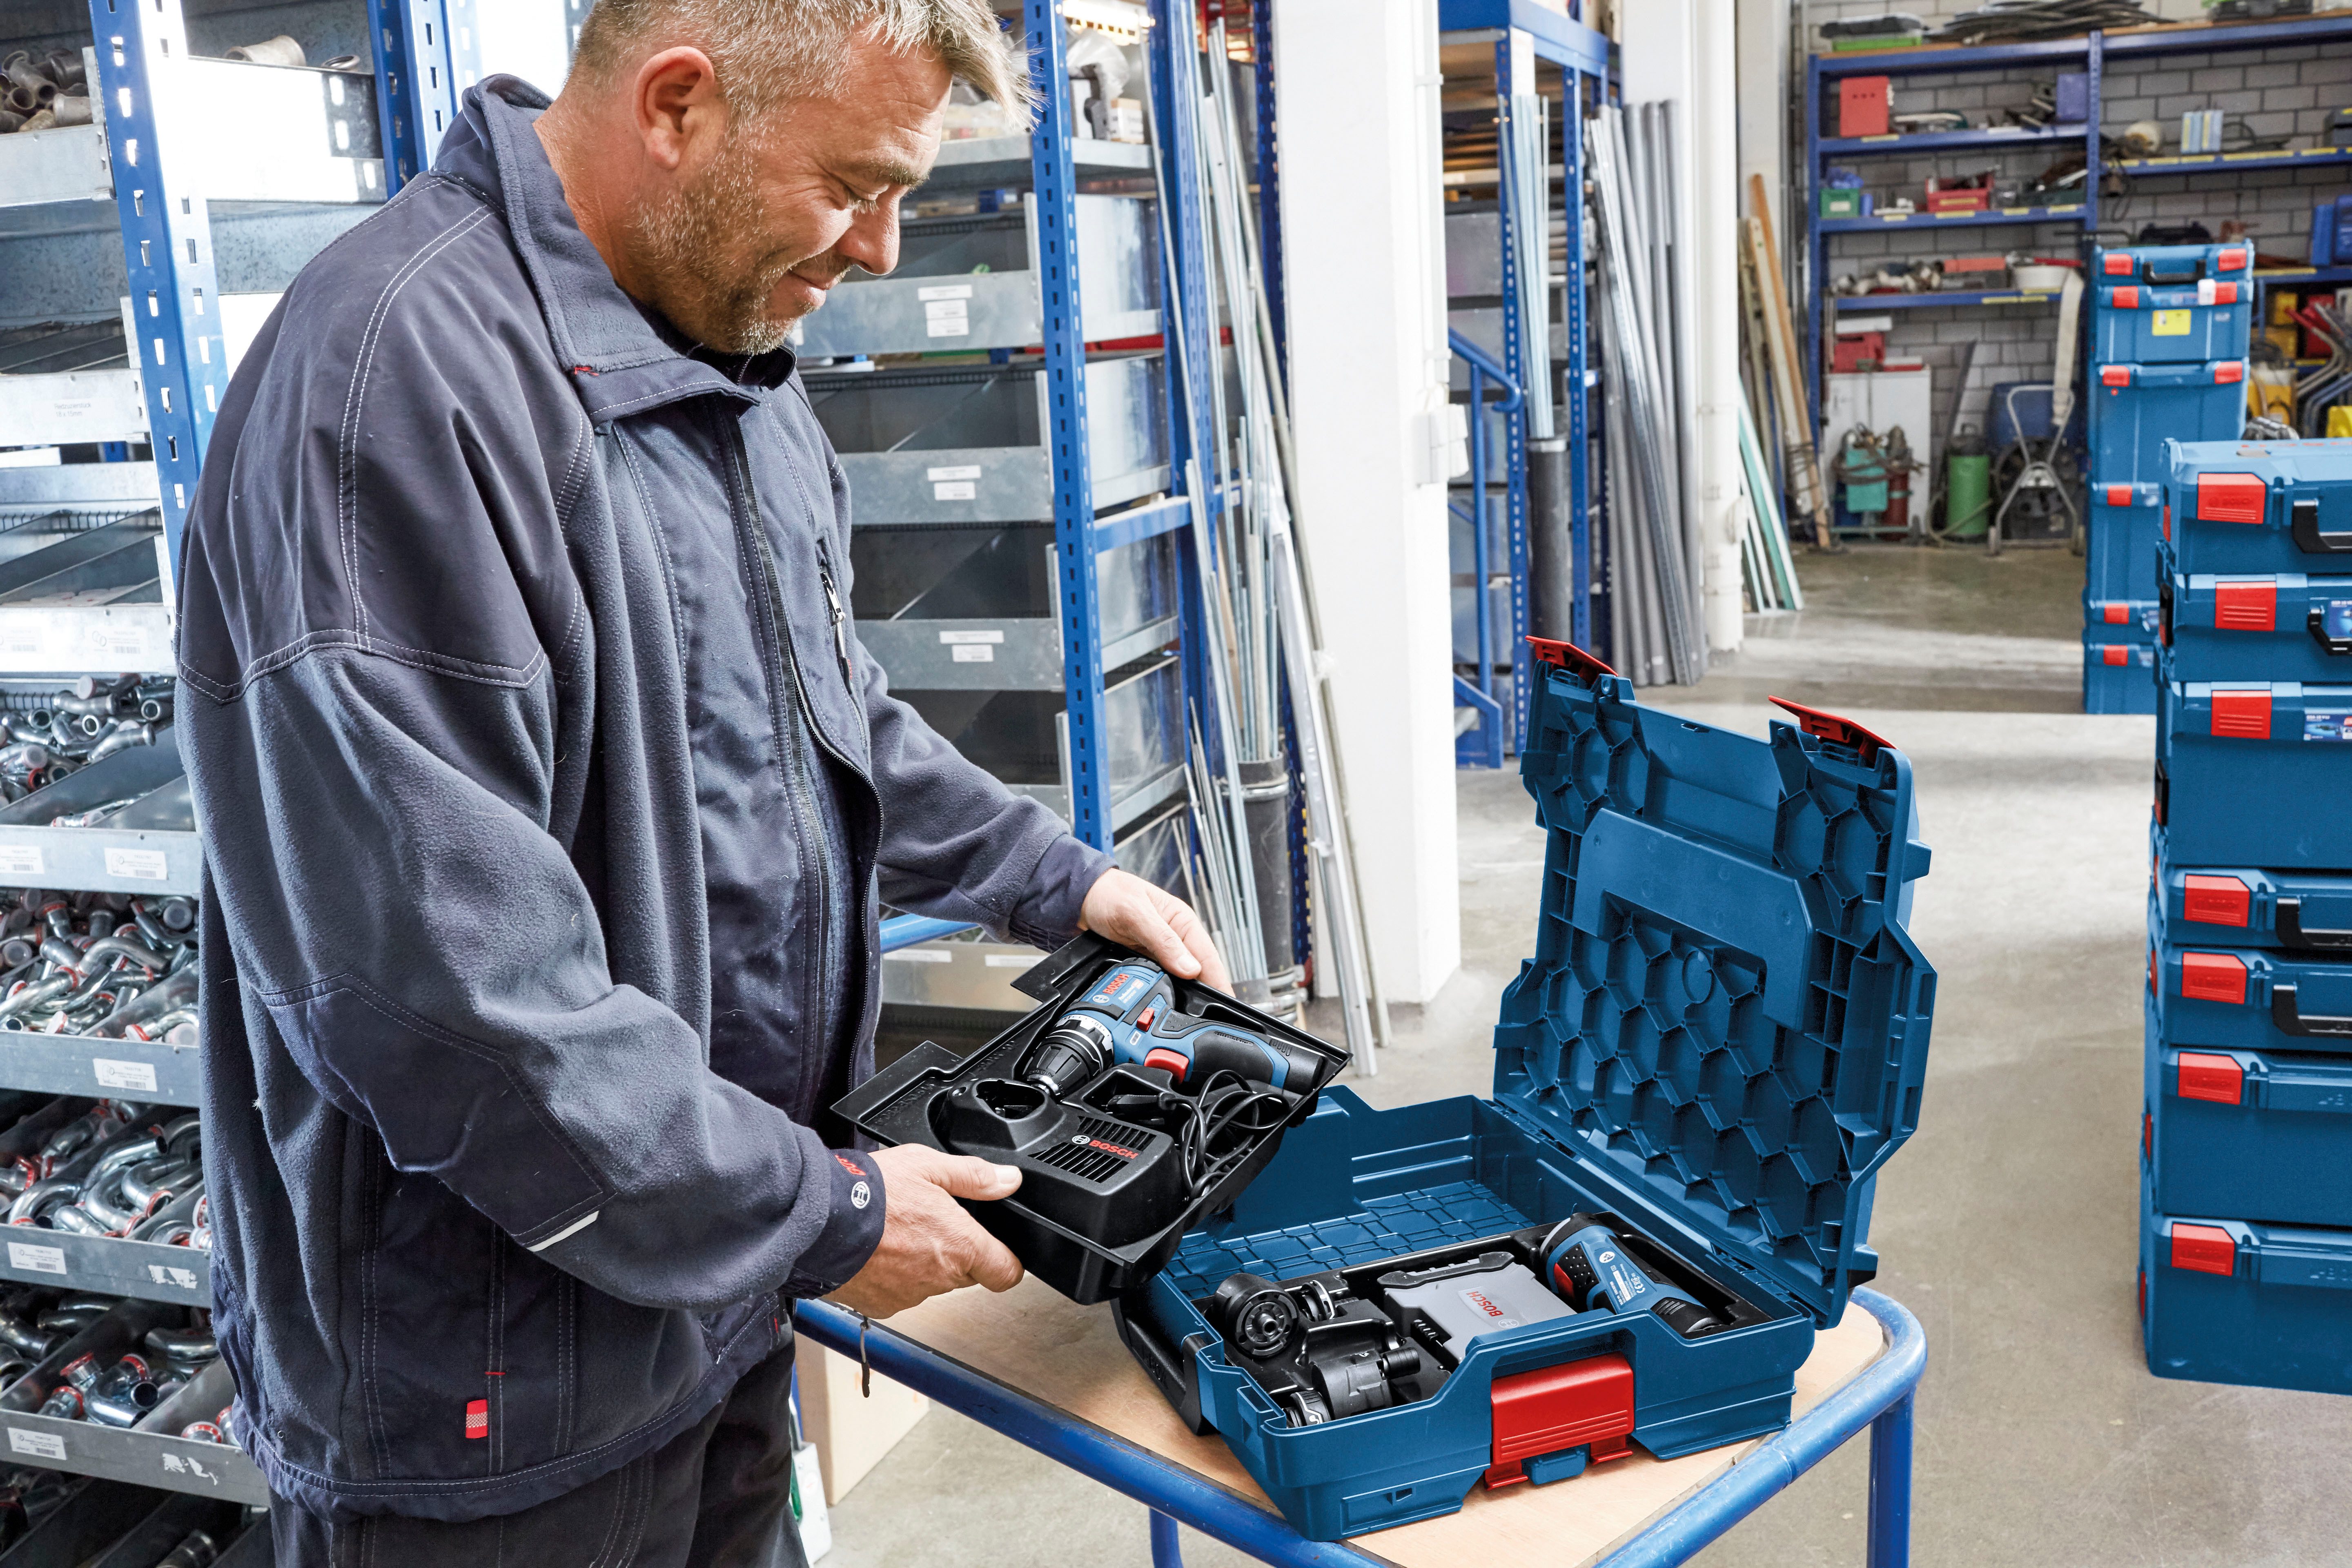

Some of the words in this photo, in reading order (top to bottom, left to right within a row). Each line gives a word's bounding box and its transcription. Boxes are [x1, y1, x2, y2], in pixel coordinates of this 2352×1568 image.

[1102, 973, 1130, 995] BOSCH
[1089, 1140, 1138, 1159] BOSCH
[1466, 1291, 1504, 1317] BOSCH
